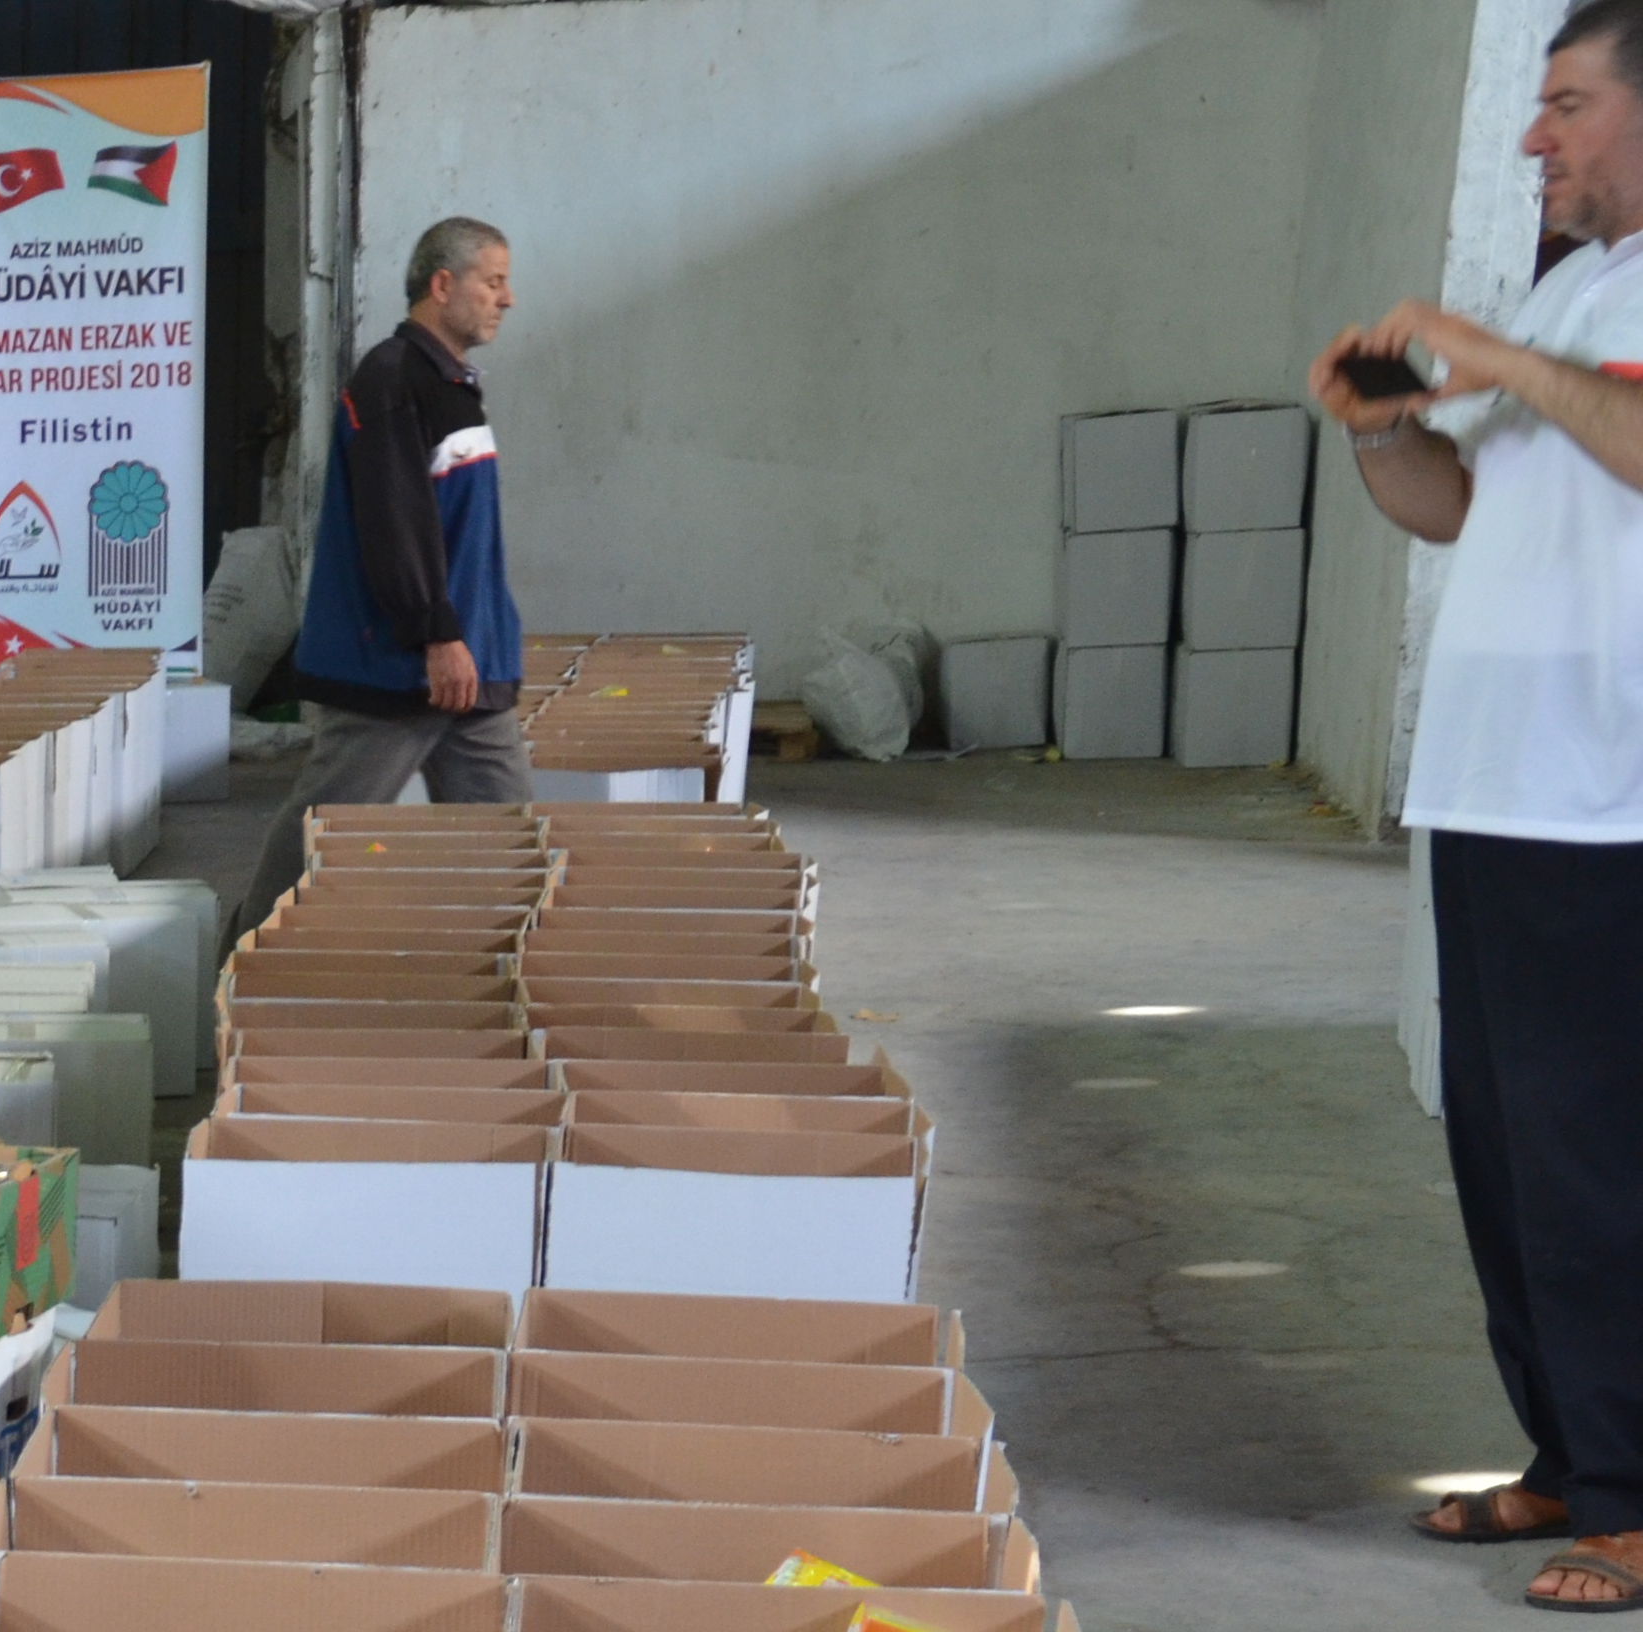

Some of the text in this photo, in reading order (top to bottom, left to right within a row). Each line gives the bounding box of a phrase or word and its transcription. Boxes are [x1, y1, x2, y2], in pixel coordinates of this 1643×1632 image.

[10, 238, 51, 260] AZİZ
[95, 266, 185, 298] VAKFI
[80, 322, 156, 351] ERZAK
[163, 321, 192, 346] VE
[30, 360, 123, 393] PROJESİ
[130, 361, 193, 389] 2018
[20, 416, 133, 444] Filistin
[102, 617, 154, 631] VAKFI
